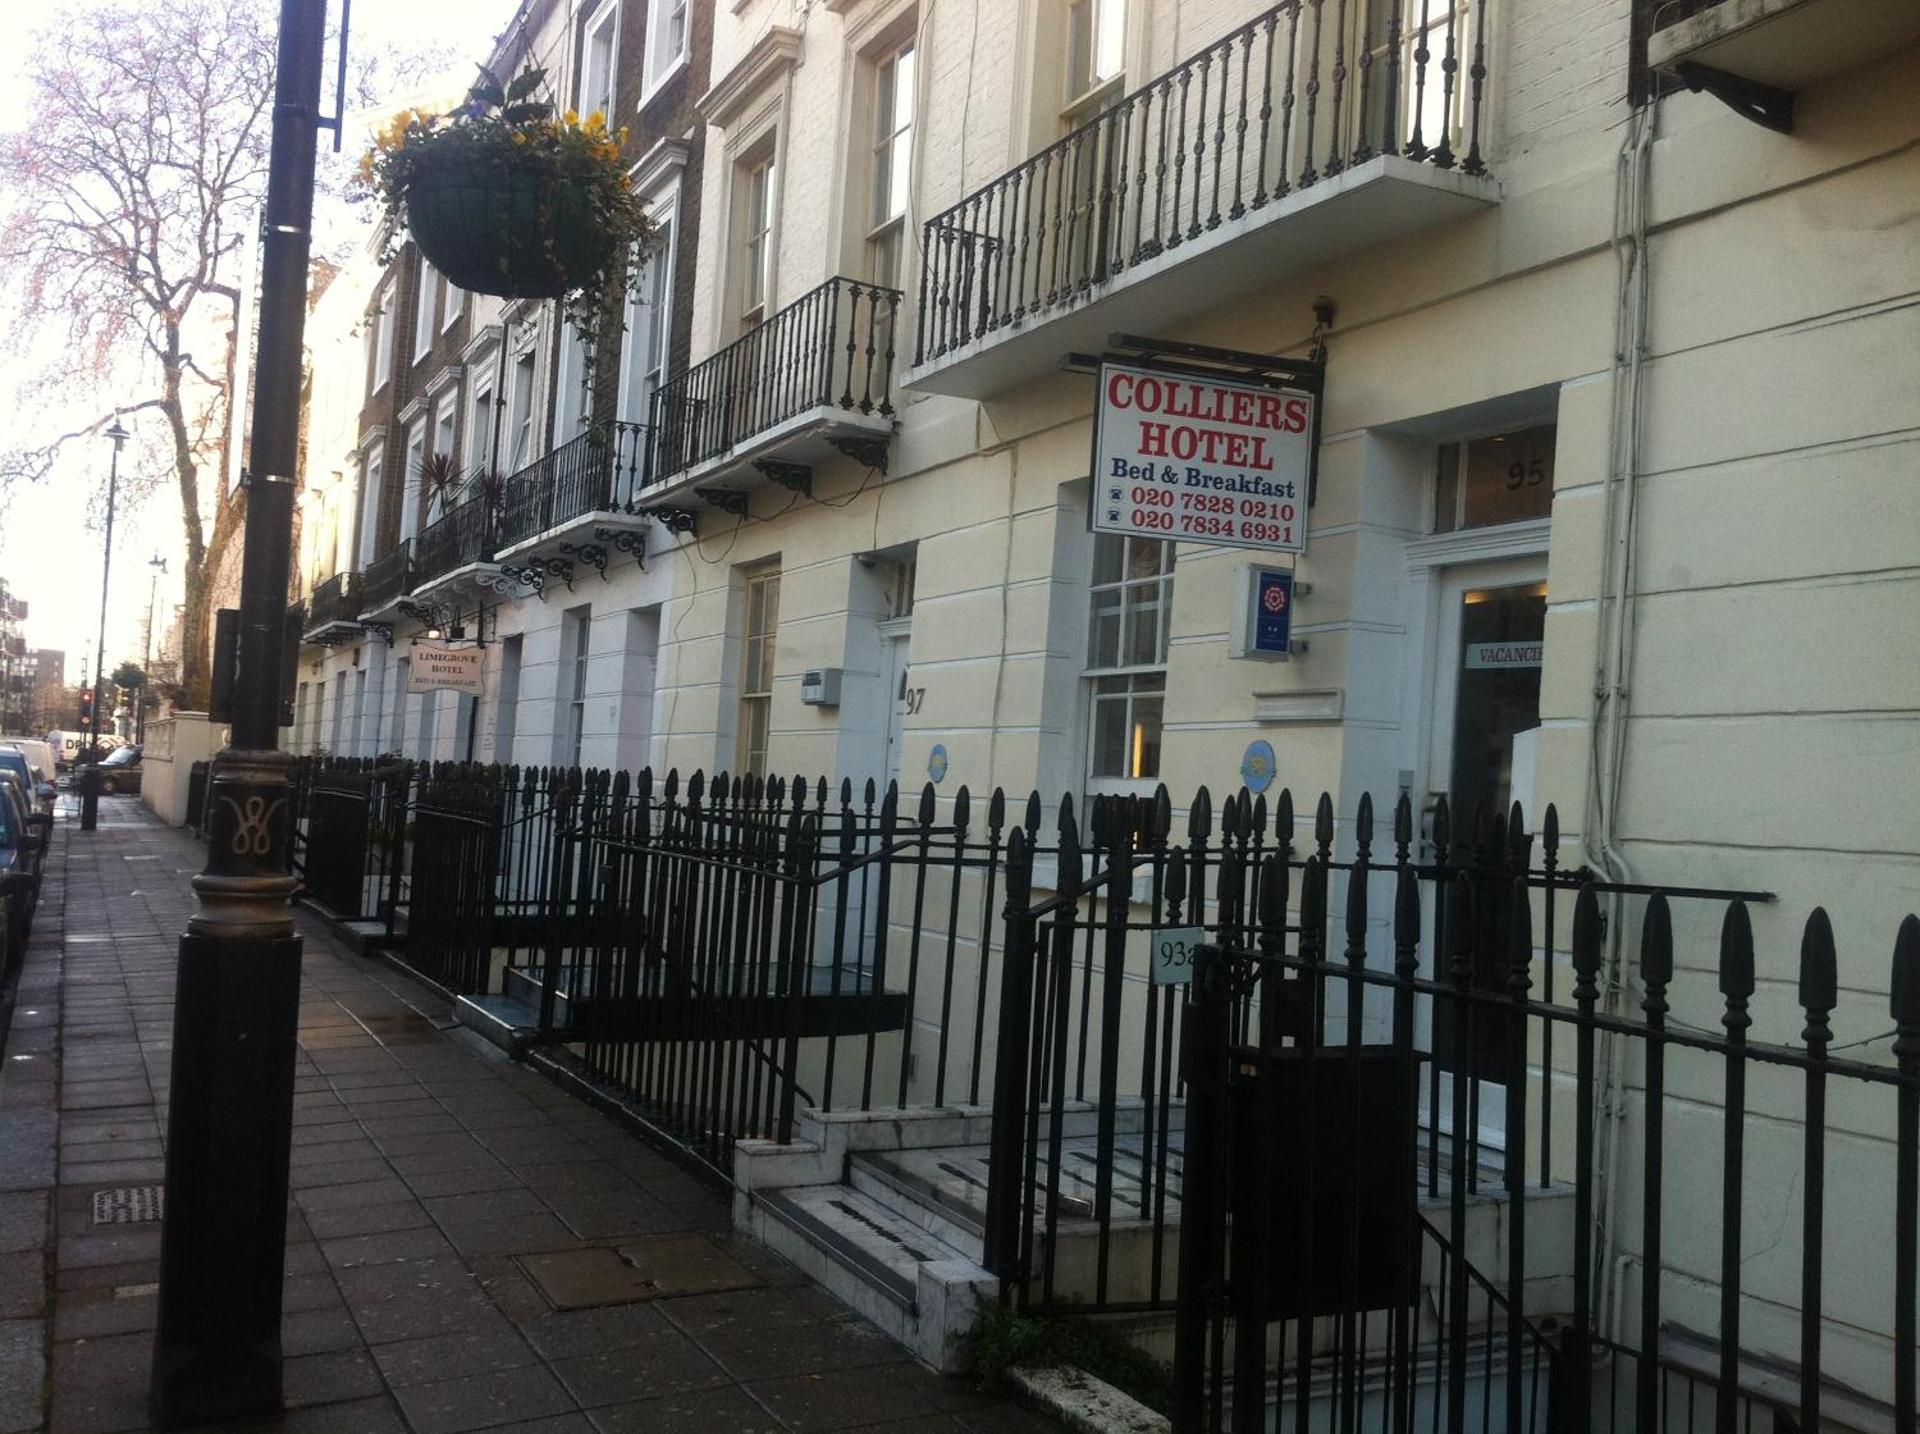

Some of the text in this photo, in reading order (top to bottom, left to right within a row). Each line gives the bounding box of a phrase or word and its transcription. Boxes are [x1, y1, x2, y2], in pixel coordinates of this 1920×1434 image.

[1108, 373, 1307, 433] COLLIERS
[1138, 421, 1274, 470] HOTEL
[1110, 457, 1295, 498] Bed & Breakfast
[1506, 459, 1545, 490] 95
[1131, 486, 1294, 522] 020 7828 0210
[1131, 508, 1293, 544] 020 7834 6931
[419, 652, 478, 664] LIMEGROVE
[432, 664, 464, 674] HOTEL
[906, 687, 926, 715] 97
